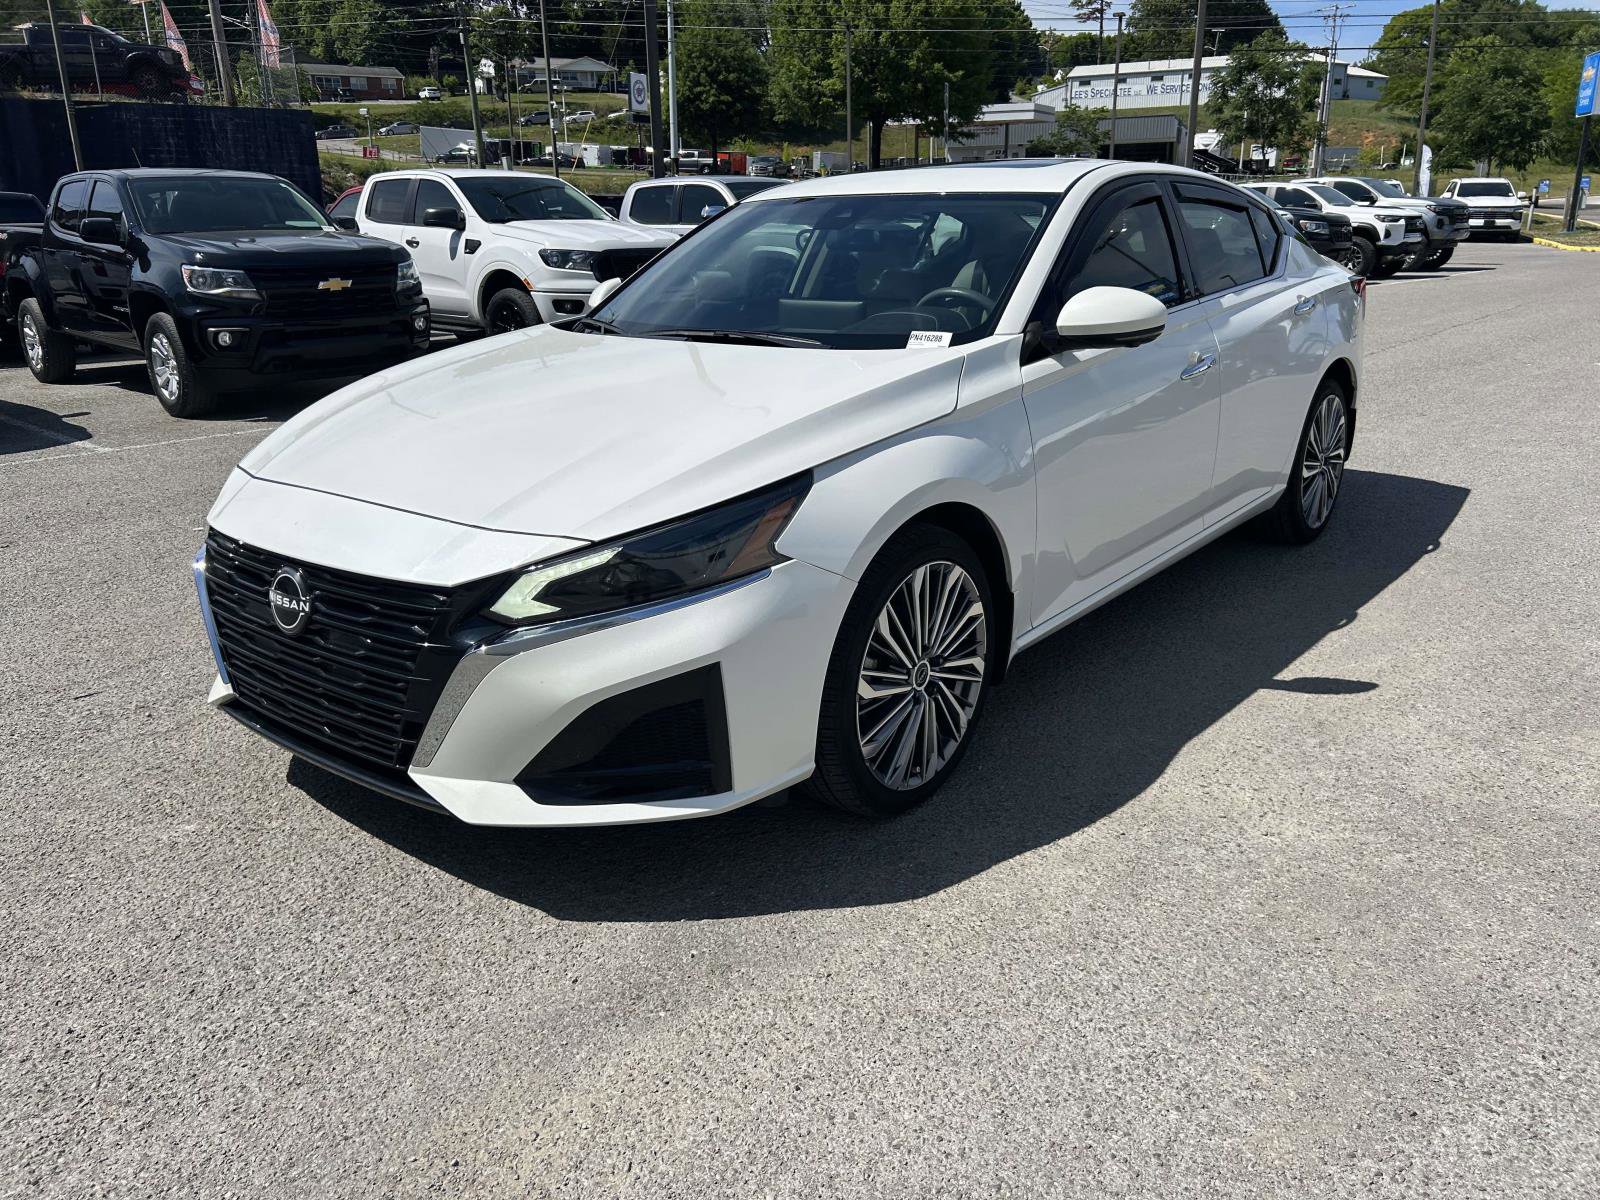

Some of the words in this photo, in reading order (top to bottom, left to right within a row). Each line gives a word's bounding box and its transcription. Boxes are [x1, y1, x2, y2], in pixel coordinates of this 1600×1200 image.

[1146, 84, 1158, 95] WE
[1160, 83, 1190, 94] SERVICE
[910, 333, 943, 343] PN416288
[269, 590, 310, 612] NISSAN
